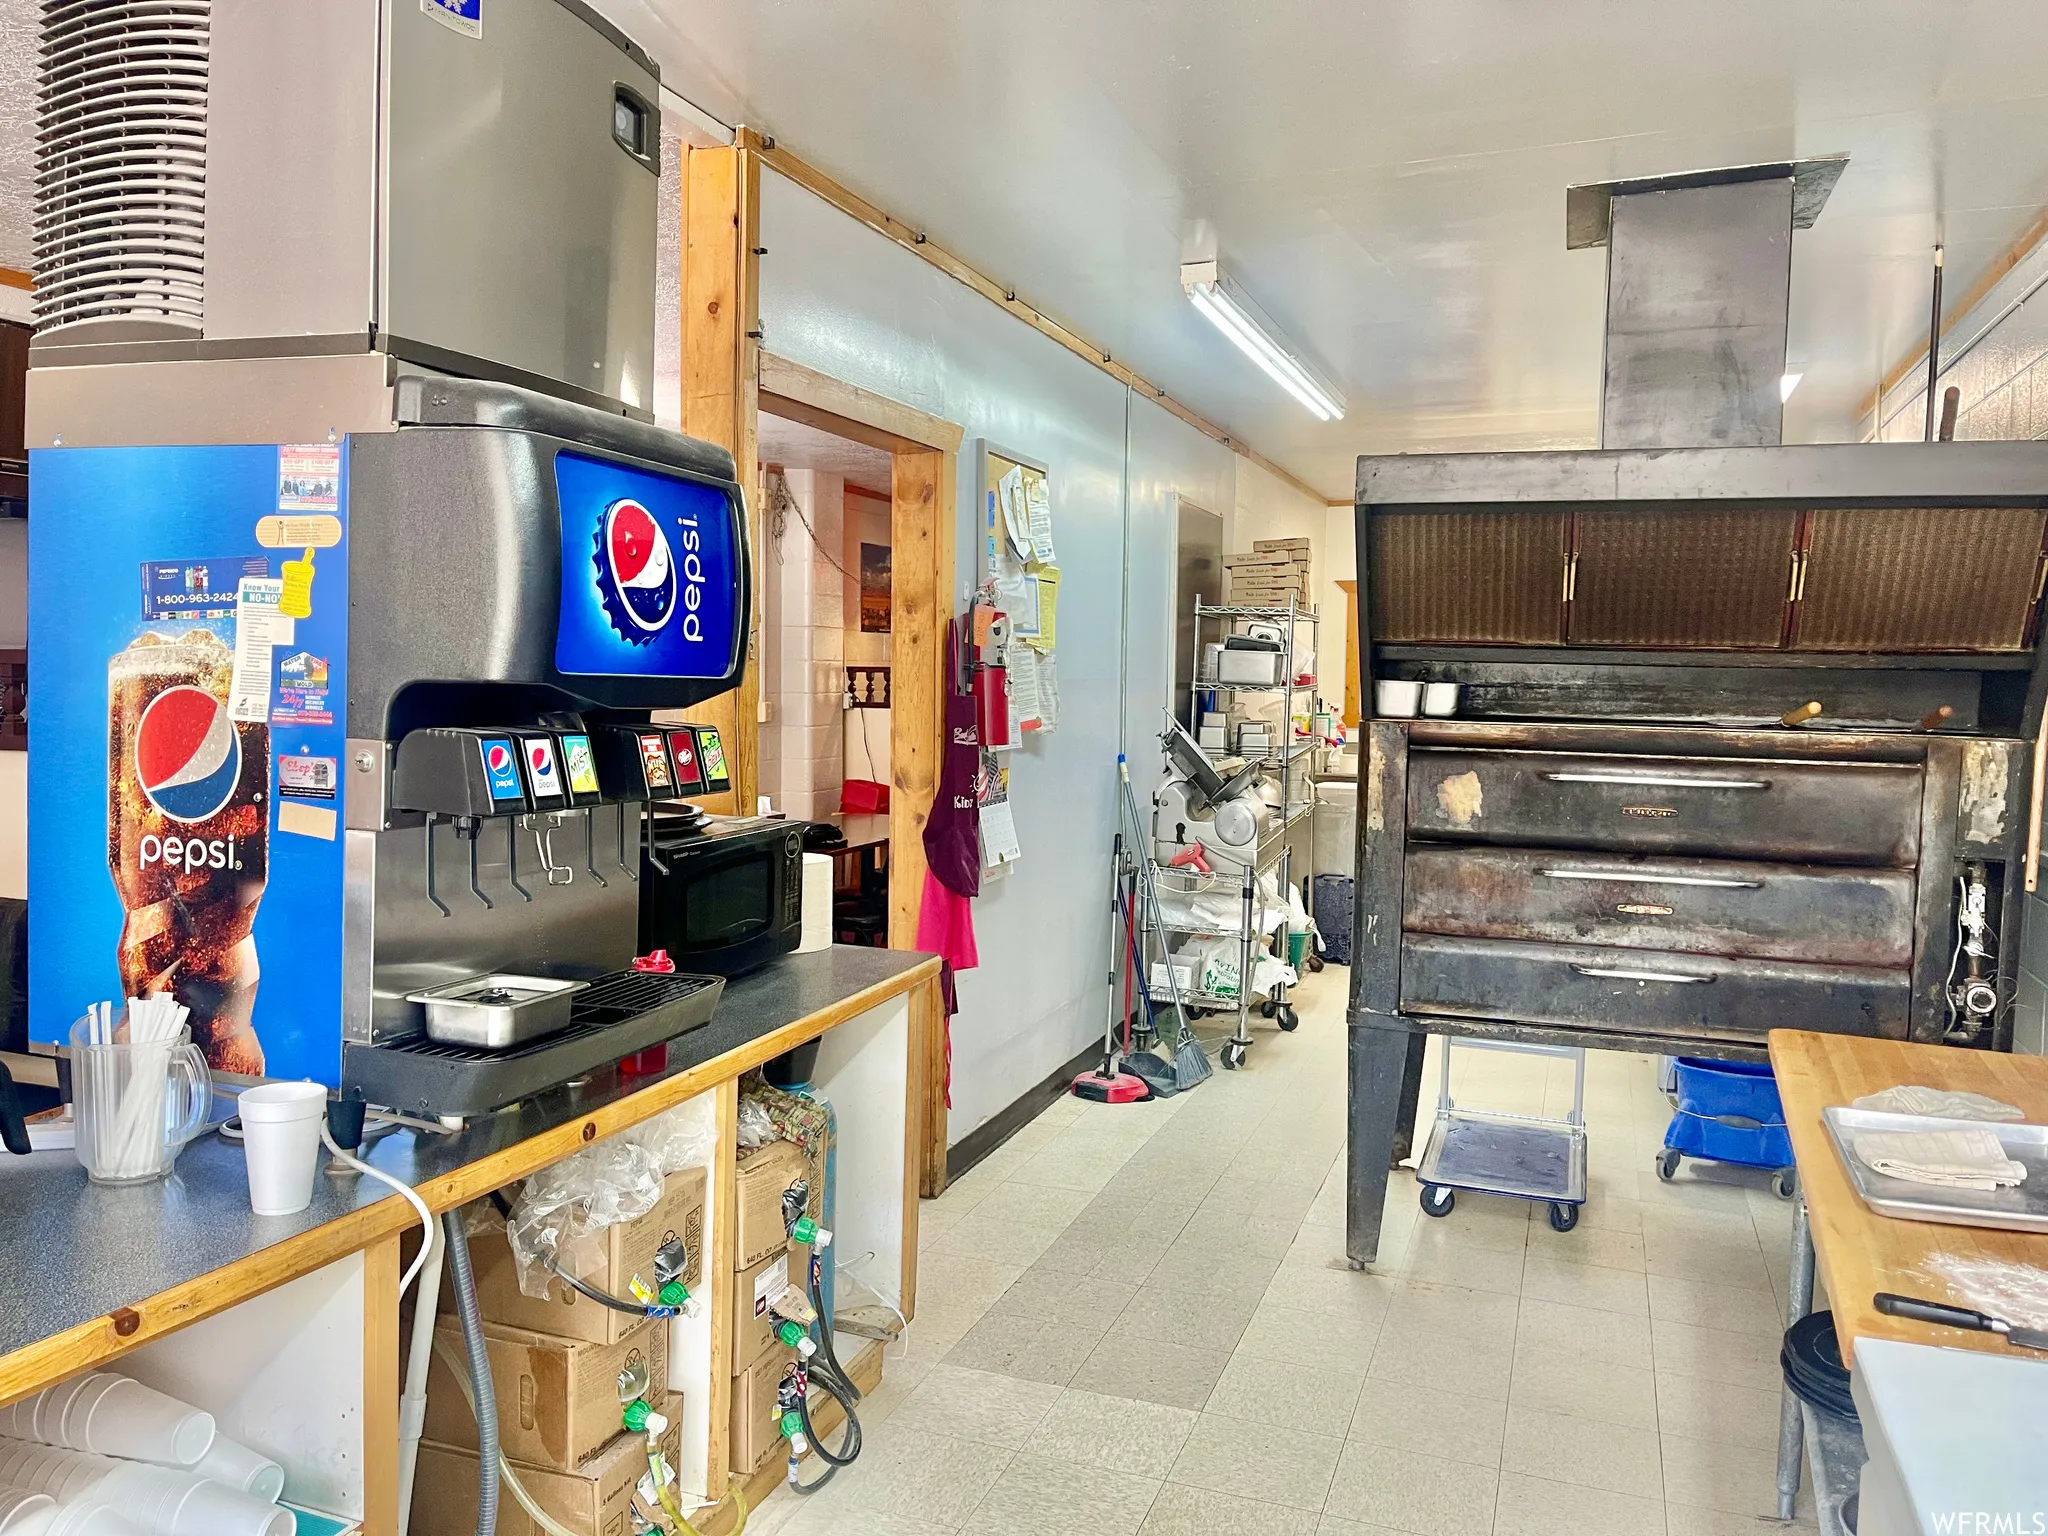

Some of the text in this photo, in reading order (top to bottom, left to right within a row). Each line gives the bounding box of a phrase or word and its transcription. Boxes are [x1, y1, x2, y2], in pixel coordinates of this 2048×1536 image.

[678, 517, 706, 642] pepsi
[264, 584, 280, 592] Your
[156, 592, 238, 604] 1-800-963-2424
[249, 593, 281, 603] NO-NO'
[282, 694, 304, 708] 24/7
[495, 778, 515, 790] pepsi
[140, 834, 235, 875] pepsi
